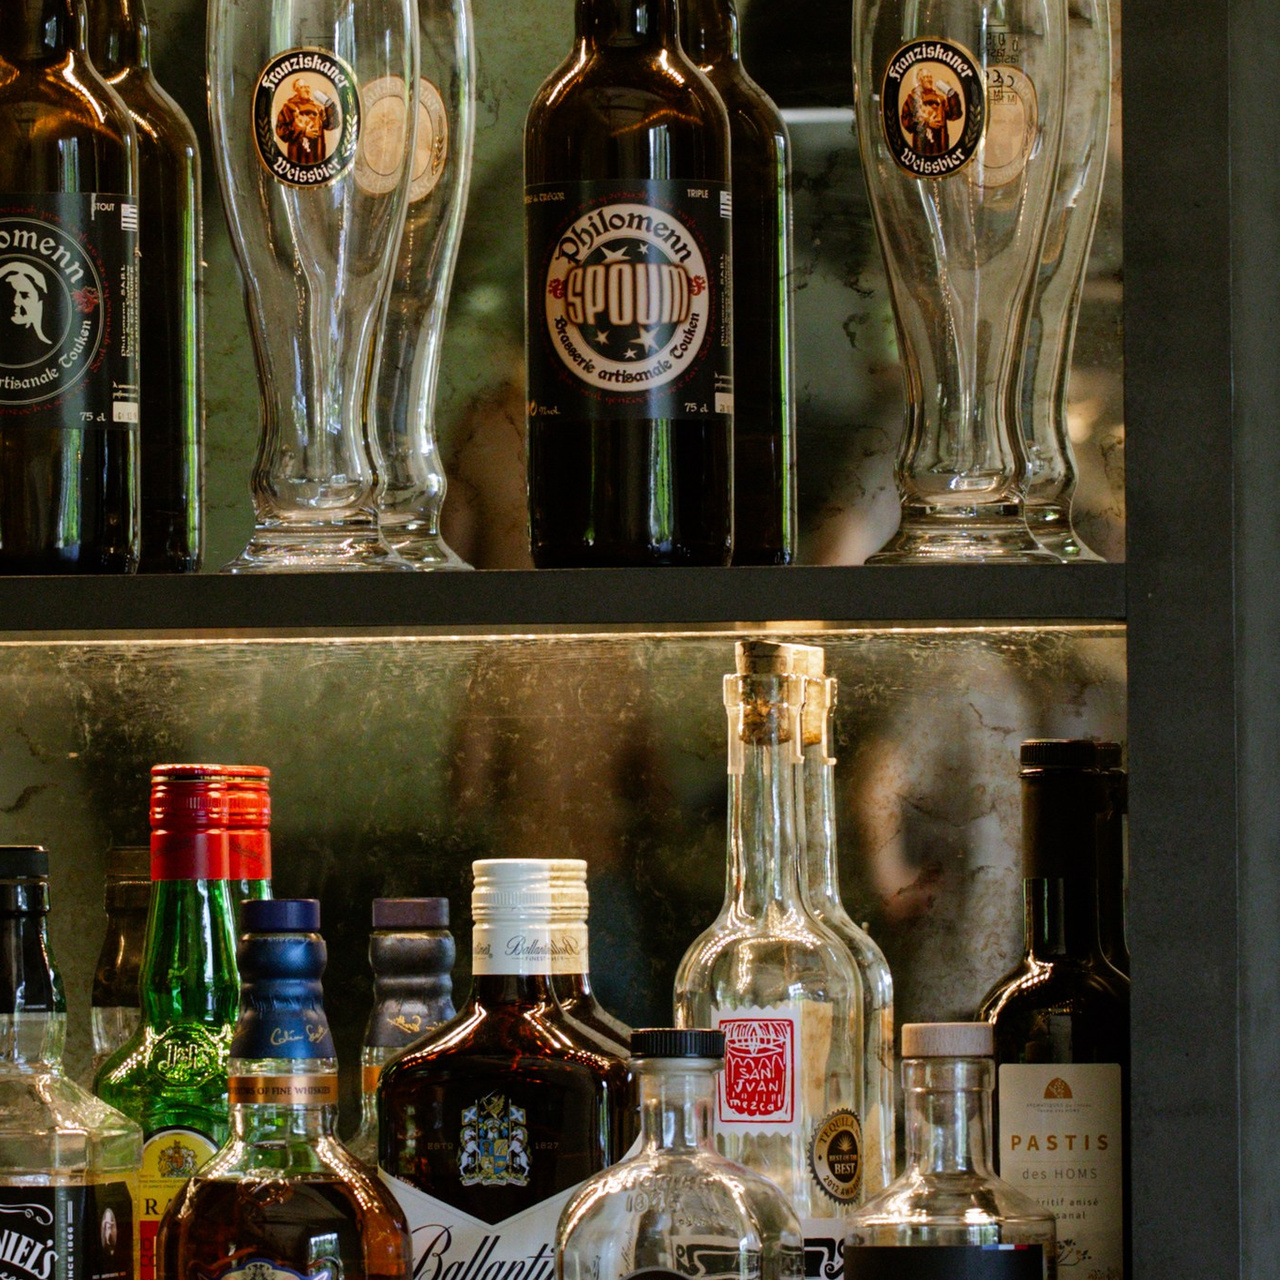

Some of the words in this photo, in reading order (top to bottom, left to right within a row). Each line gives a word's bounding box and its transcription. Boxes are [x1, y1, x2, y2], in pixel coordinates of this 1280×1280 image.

[261, 53, 350, 93] Franziskaner
[887, 43, 974, 83] Franziskaner
[272, 156, 342, 183] Weissbier
[899, 146, 966, 174] Weissbier
[686, 188, 709, 199] TRIPLE
[93, 202, 115, 212] STOUT
[554, 208, 693, 266] Philomenn
[58, 319, 92, 370] Touken
[554, 314, 596, 375] Brasserie
[597, 359, 673, 385] artisanale
[669, 312, 701, 360] Touken
[739, 1067, 772, 1081] SAN
[729, 1093, 782, 1112] mezcal
[1010, 1134, 1109, 1151] PASTIS
[834, 1162, 856, 1174] BEST
[1022, 1168, 1047, 1180] des
[1054, 1168, 1098, 1180] HOMS
